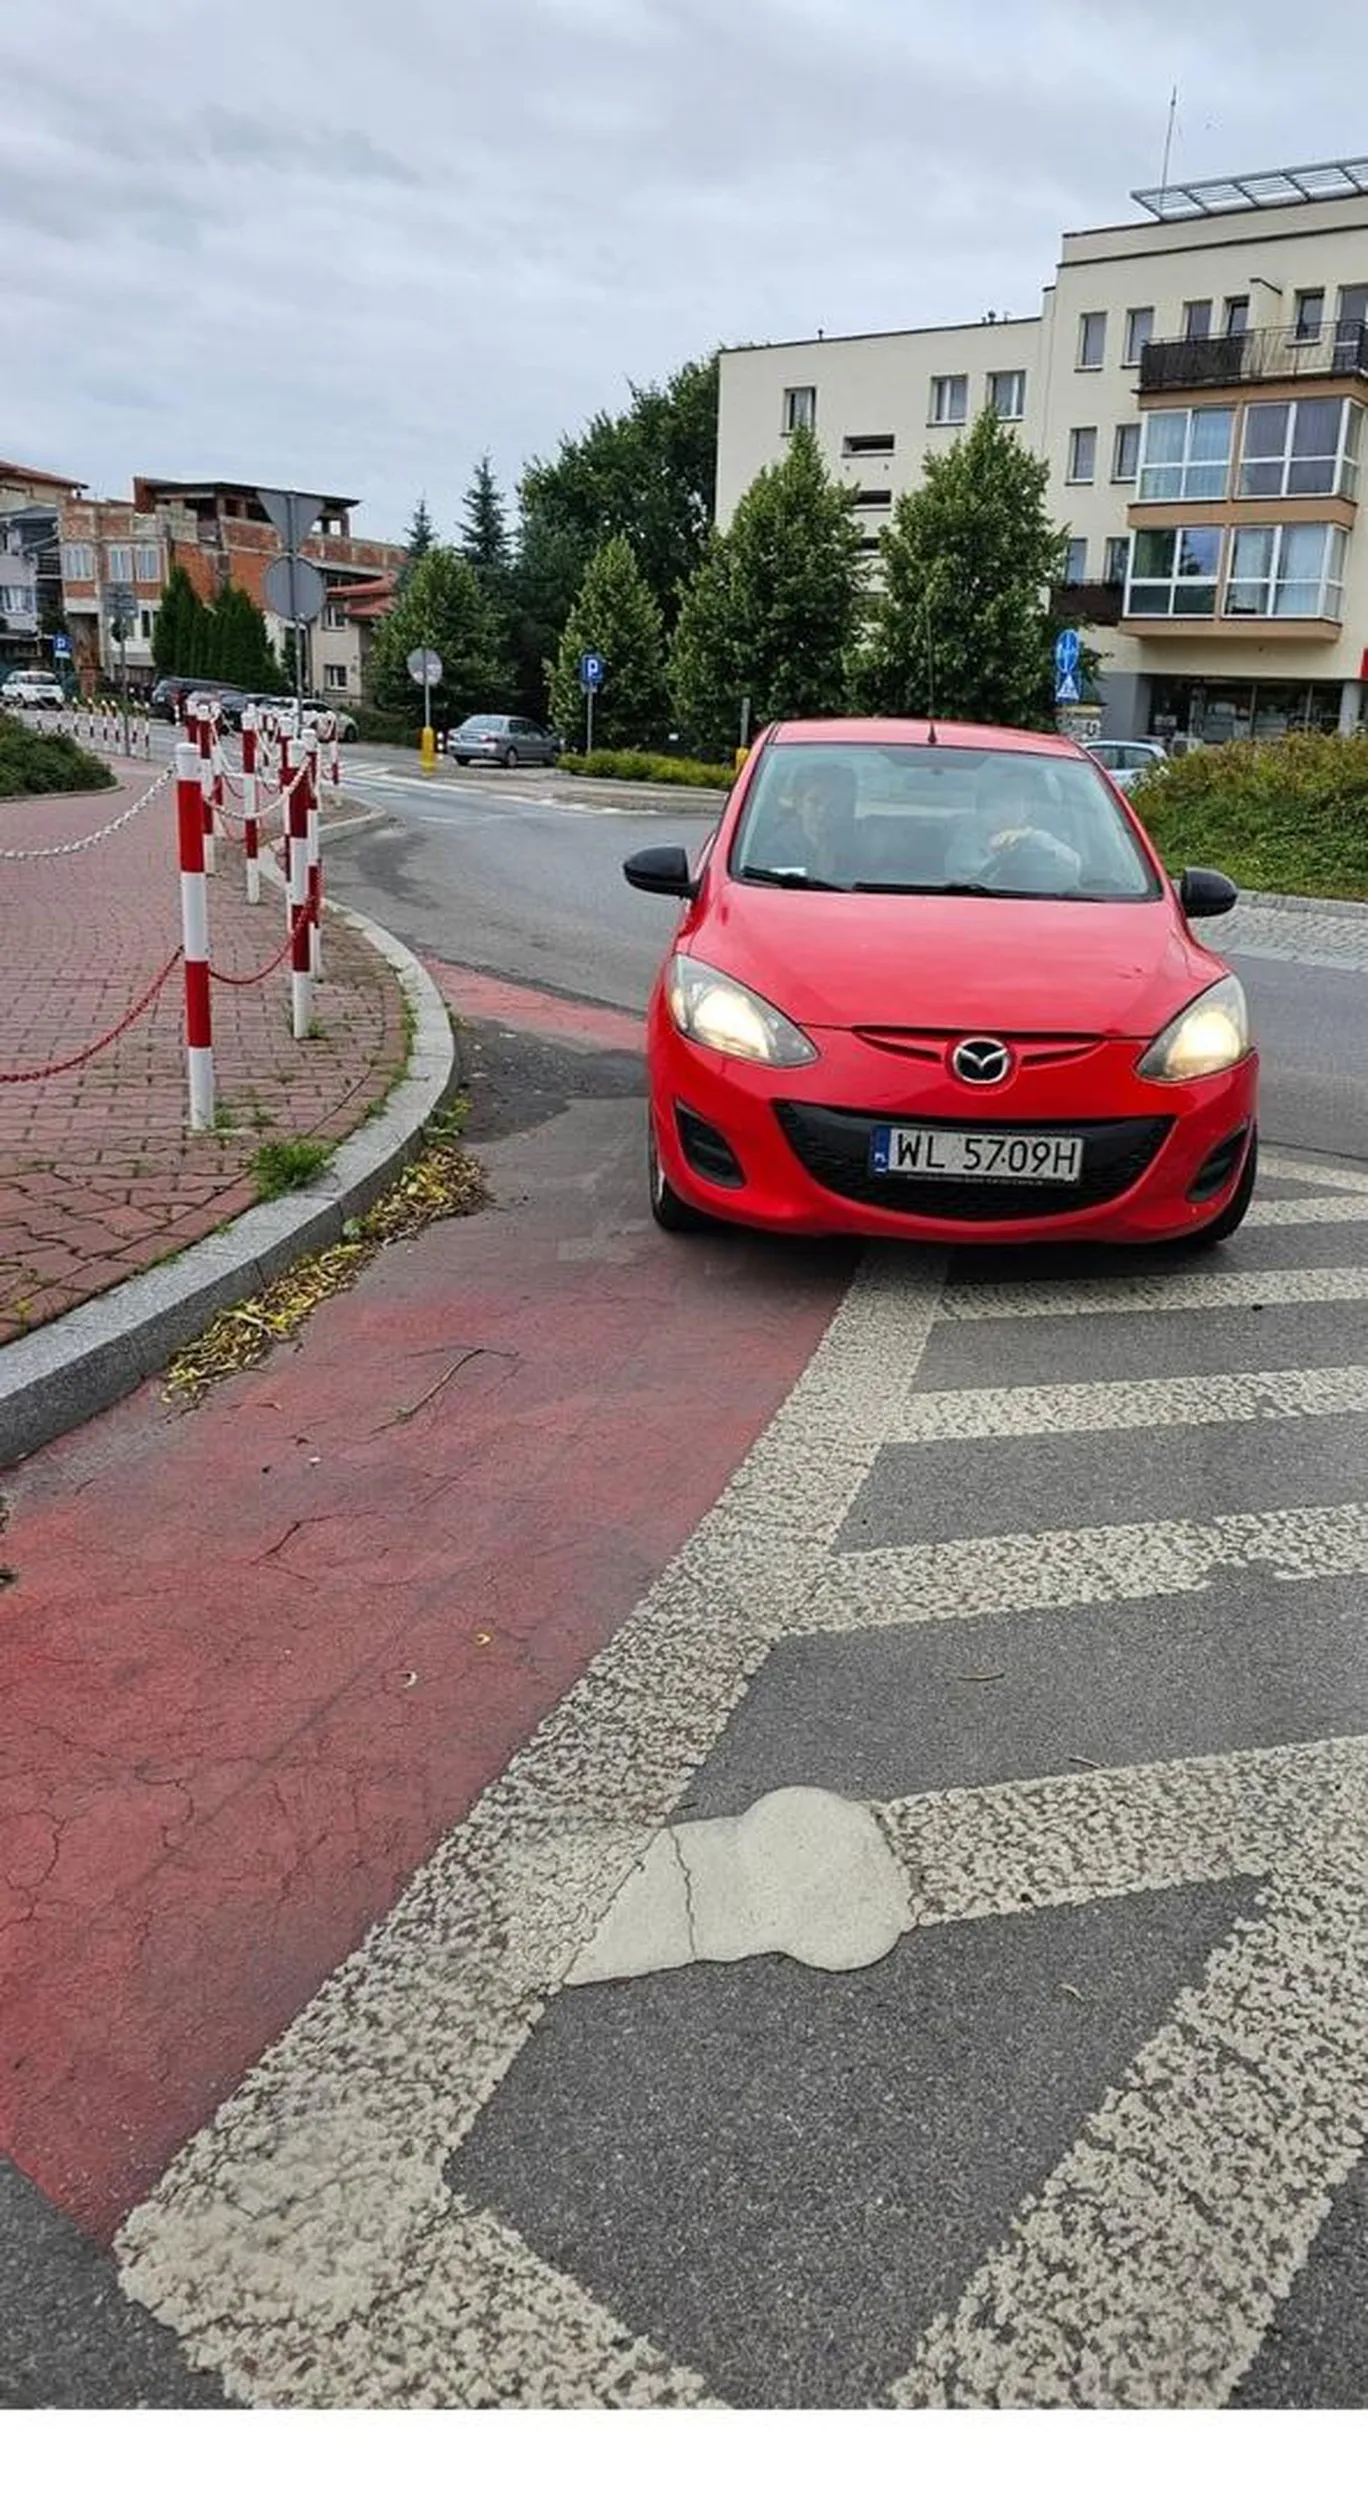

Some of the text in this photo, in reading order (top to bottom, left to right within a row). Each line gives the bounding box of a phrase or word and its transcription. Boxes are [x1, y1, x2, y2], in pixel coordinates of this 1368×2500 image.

[587, 659, 598, 677] P
[896, 1133, 1077, 1175] WL 5709H
